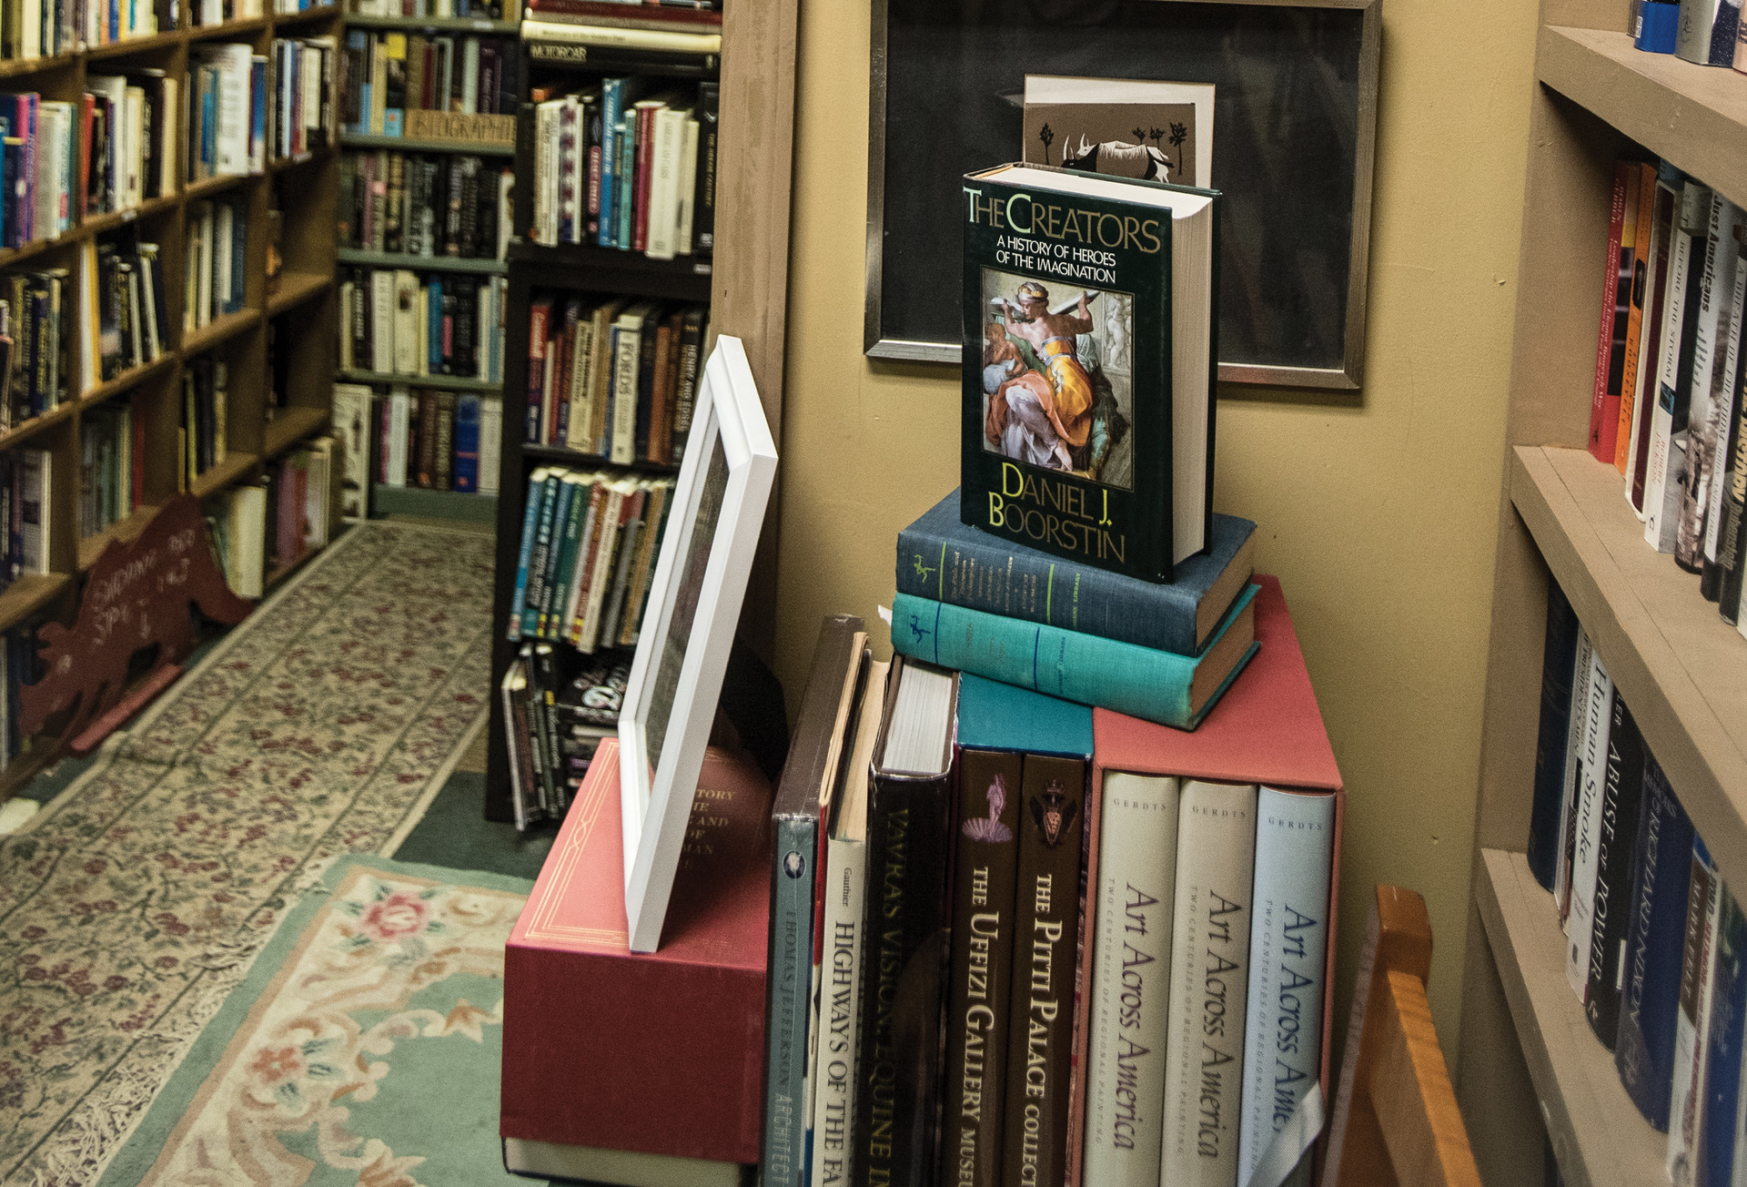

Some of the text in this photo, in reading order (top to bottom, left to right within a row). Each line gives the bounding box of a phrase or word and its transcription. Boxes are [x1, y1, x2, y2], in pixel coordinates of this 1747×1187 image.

[963, 186, 1161, 254] THE CREATORS
[996, 234, 1116, 266] A HISTORY OF HEROES
[1702, 195, 1724, 312] Just Americans
[996, 250, 1116, 284] OF THE IMAGINATION
[1665, 241, 1684, 378] BEFORE THE STORM
[1718, 369, 1732, 442] FREEDOM
[988, 492, 1126, 564] BOORSTIN
[1002, 462, 1112, 526] DANIEL J.
[1072, 572, 1081, 603] LIBRARY
[696, 789, 736, 800] TORY
[1580, 663, 1607, 864] Human Smoke
[1604, 741, 1621, 842] ABUSE
[1113, 798, 1167, 811] GERDTS
[1192, 805, 1246, 818] GERDTS
[1268, 816, 1323, 830] GERDTS
[842, 866, 852, 908] Gauthier
[1600, 842, 1608, 871] OF
[1640, 812, 1661, 937] RICHARD
[1190, 886, 1198, 914] TWO
[1282, 904, 1318, 959] Art
[1592, 876, 1609, 980] POWER
[784, 910, 797, 982] THOMAS
[1102, 910, 1114, 982] CENTURIES
[1186, 916, 1196, 992] CENTURIES
[1259, 932, 1270, 1006] CENTURIES
[1684, 880, 1702, 999] MARK FELT
[828, 920, 854, 1052] HIGHWAYS
[1102, 988, 1110, 1004] OF
[1113, 882, 1160, 1150] Art Across America
[1277, 962, 1314, 1054] Across
[1630, 934, 1648, 1031] NIXON
[779, 984, 796, 1086] JEFFERSON
[958, 866, 999, 1187] THE UFFIZI GALLERY MUSEU
[1022, 874, 1063, 1187] THE PITTI PALACE COLLECT
[1198, 889, 1244, 1159] Art Across America
[827, 1060, 848, 1093] OF
[824, 1100, 847, 1150] THE
